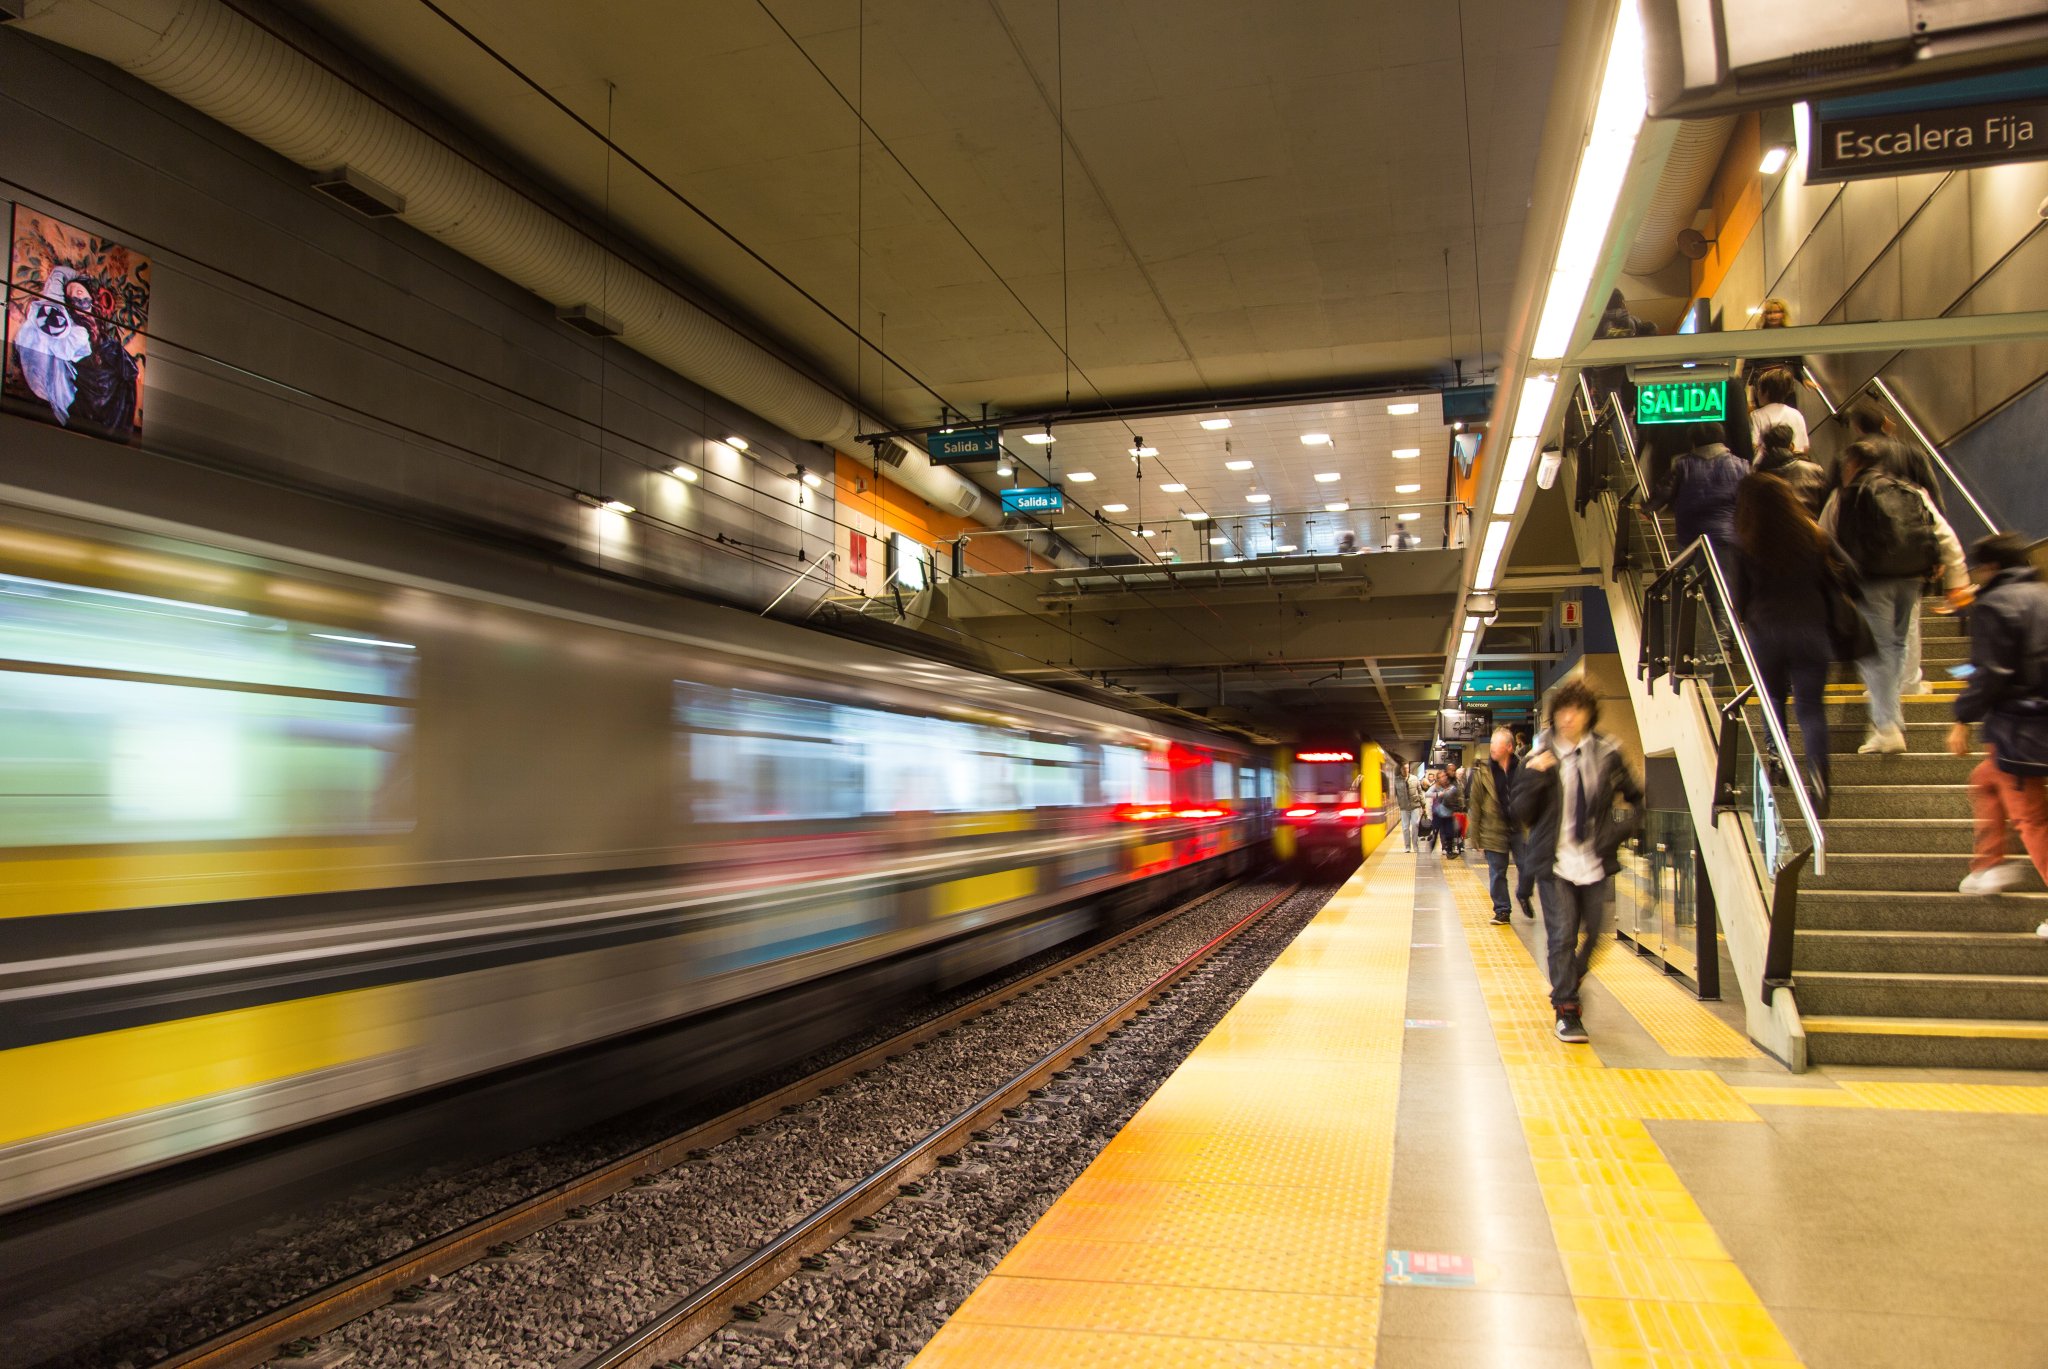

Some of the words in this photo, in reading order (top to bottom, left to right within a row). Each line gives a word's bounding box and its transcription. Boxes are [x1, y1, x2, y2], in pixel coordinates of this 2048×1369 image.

[1836, 123, 1973, 160] Escalera
[1985, 115, 2034, 149] Fija
[1641, 387, 1722, 415] SALIDA
[943, 441, 979, 454] Salida
[1018, 496, 1048, 508] Salida
